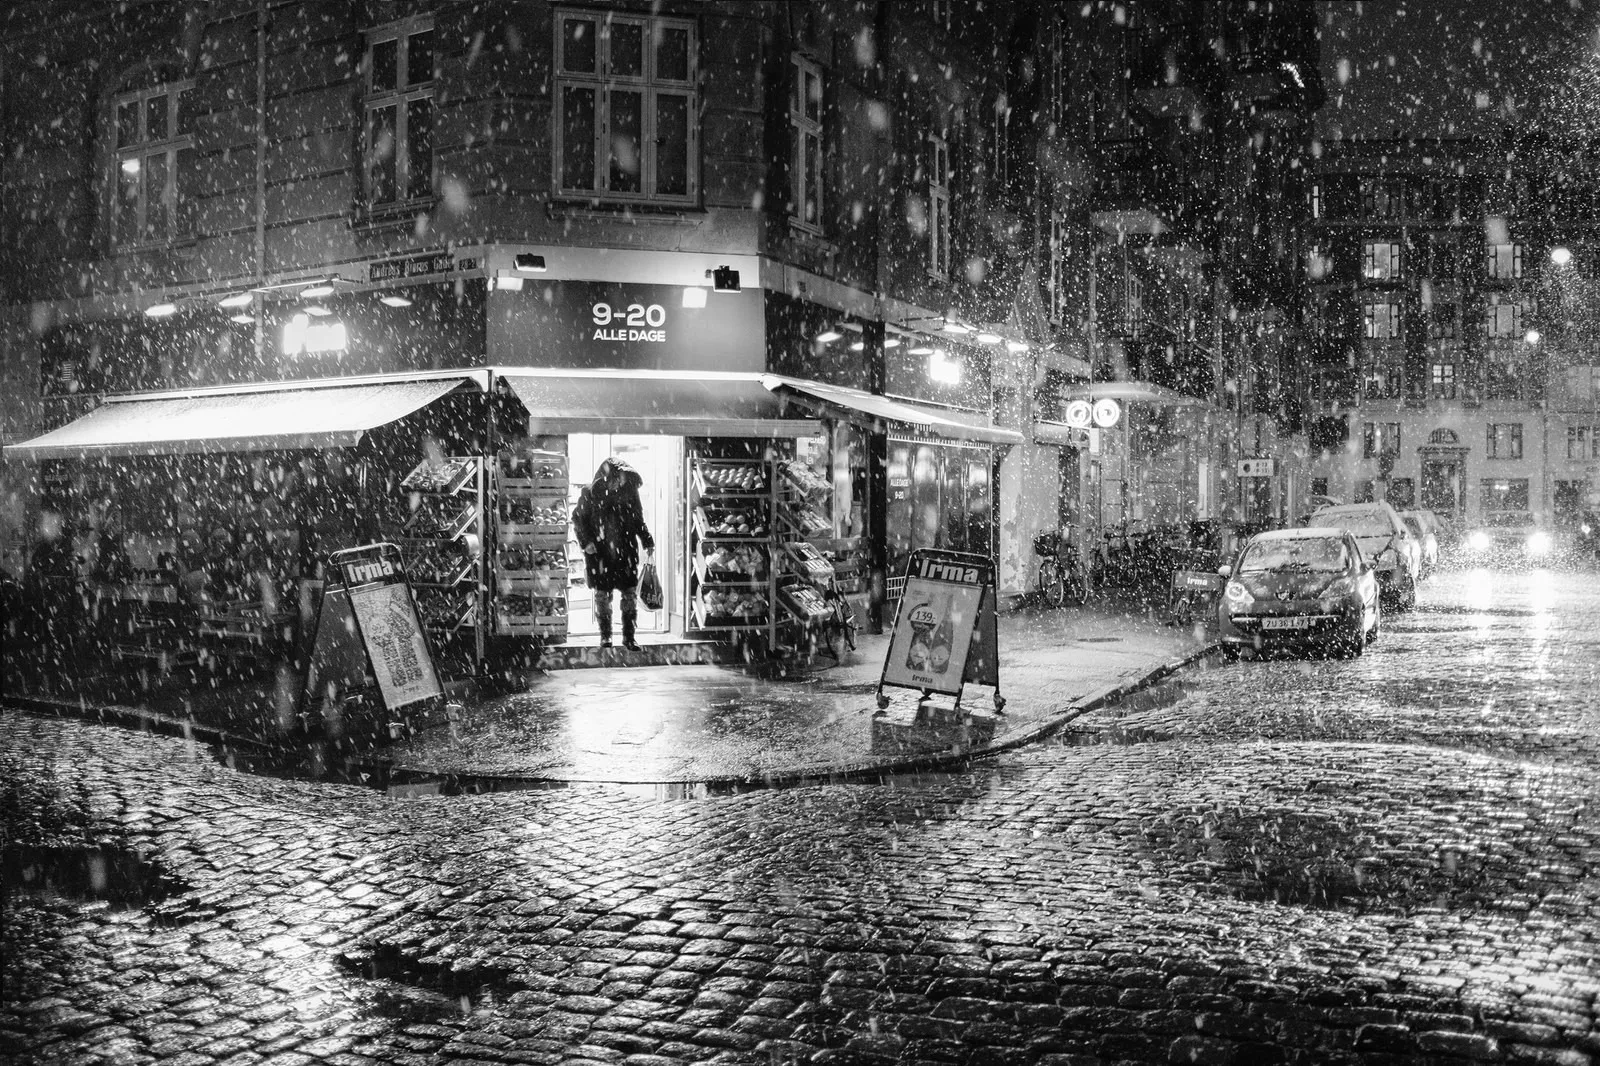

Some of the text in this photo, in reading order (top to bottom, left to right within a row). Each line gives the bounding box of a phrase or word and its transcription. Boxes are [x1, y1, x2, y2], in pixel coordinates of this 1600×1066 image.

[592, 303, 665, 327] 9-20
[593, 329, 666, 342] ALLE DAGE
[347, 561, 394, 583] Irma
[919, 559, 979, 583] Irma
[1186, 576, 1208, 586] Irma
[911, 673, 934, 684] Irma
